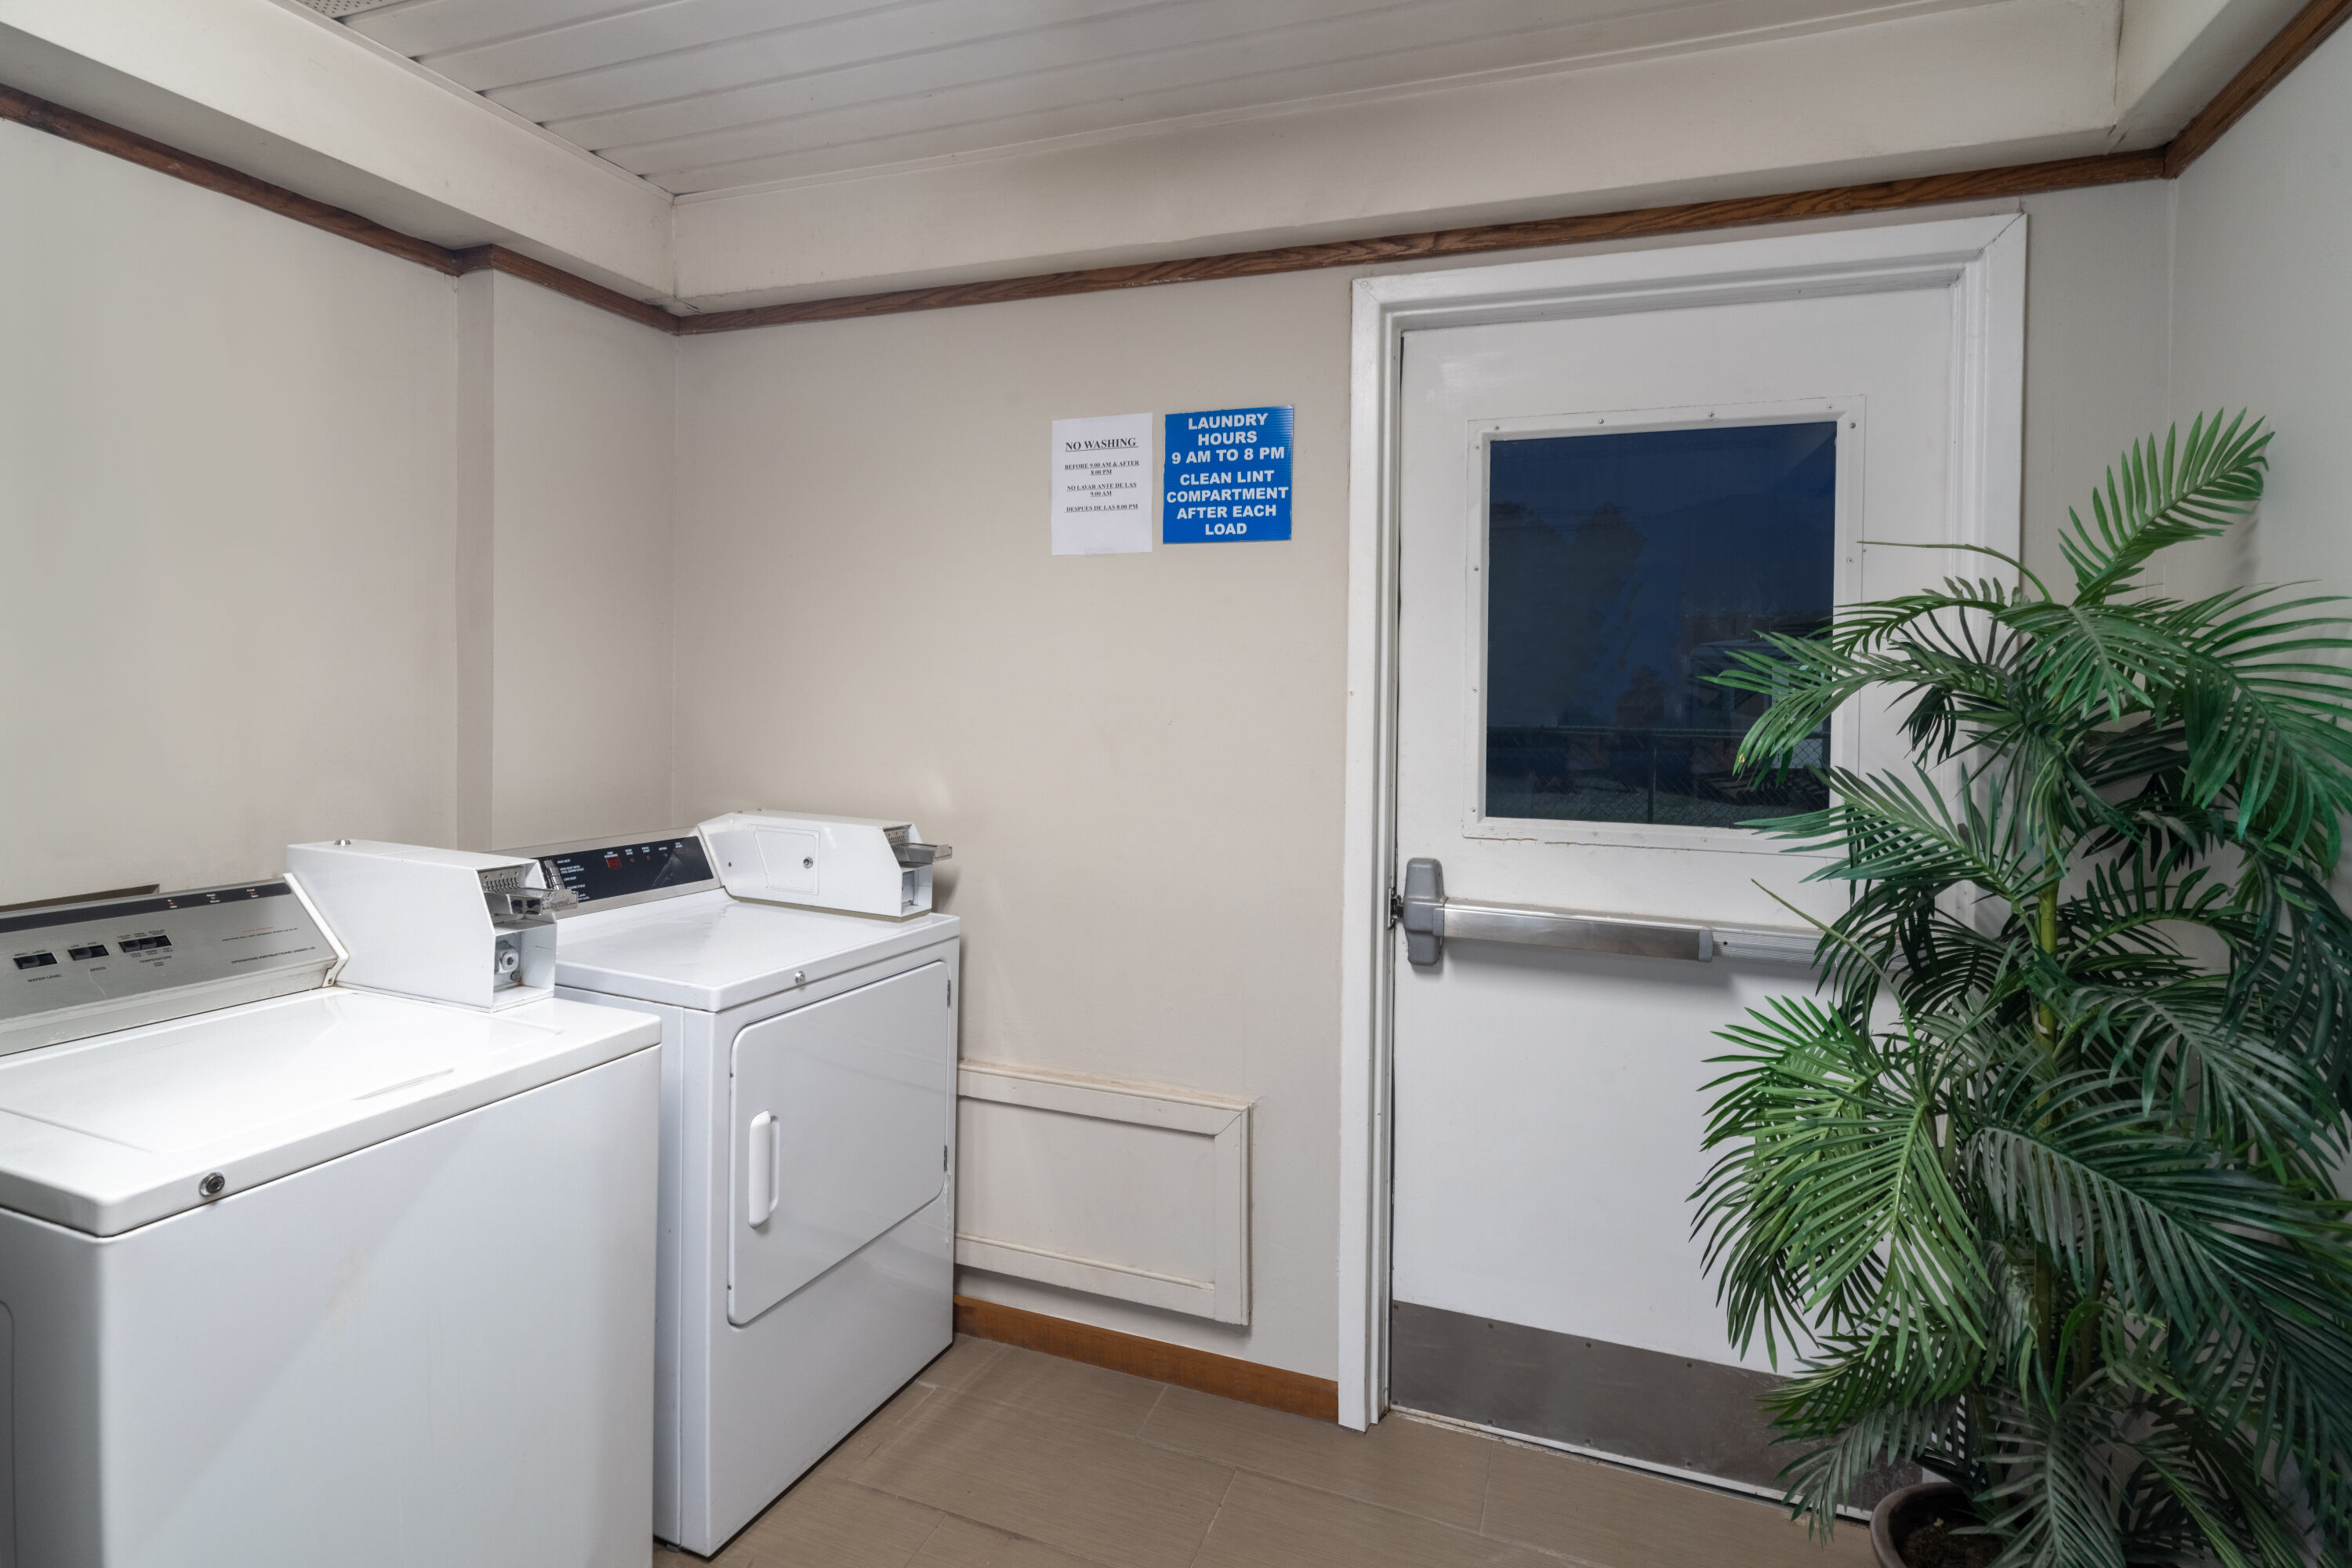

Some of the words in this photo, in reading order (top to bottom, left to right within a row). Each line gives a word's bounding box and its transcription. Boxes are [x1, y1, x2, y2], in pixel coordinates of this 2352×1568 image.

[1188, 413, 1269, 430] LAUNDRY
[1065, 441, 1081, 451] NO
[1084, 437, 1136, 450] WASHING
[1198, 431, 1258, 446] HOURS
[1171, 452, 1181, 464] 9
[1185, 450, 1210, 463] AM
[1216, 448, 1239, 462] TO
[1243, 448, 1254, 460] 8
[1259, 446, 1285, 459] PM
[1180, 472, 1232, 485] CLEAN
[1237, 470, 1275, 483] LINT
[1167, 487, 1289, 503] COMPARTMENT
[1177, 506, 1228, 519] AFTER
[1232, 504, 1276, 517] EACH
[1205, 523, 1247, 535] LOAD
